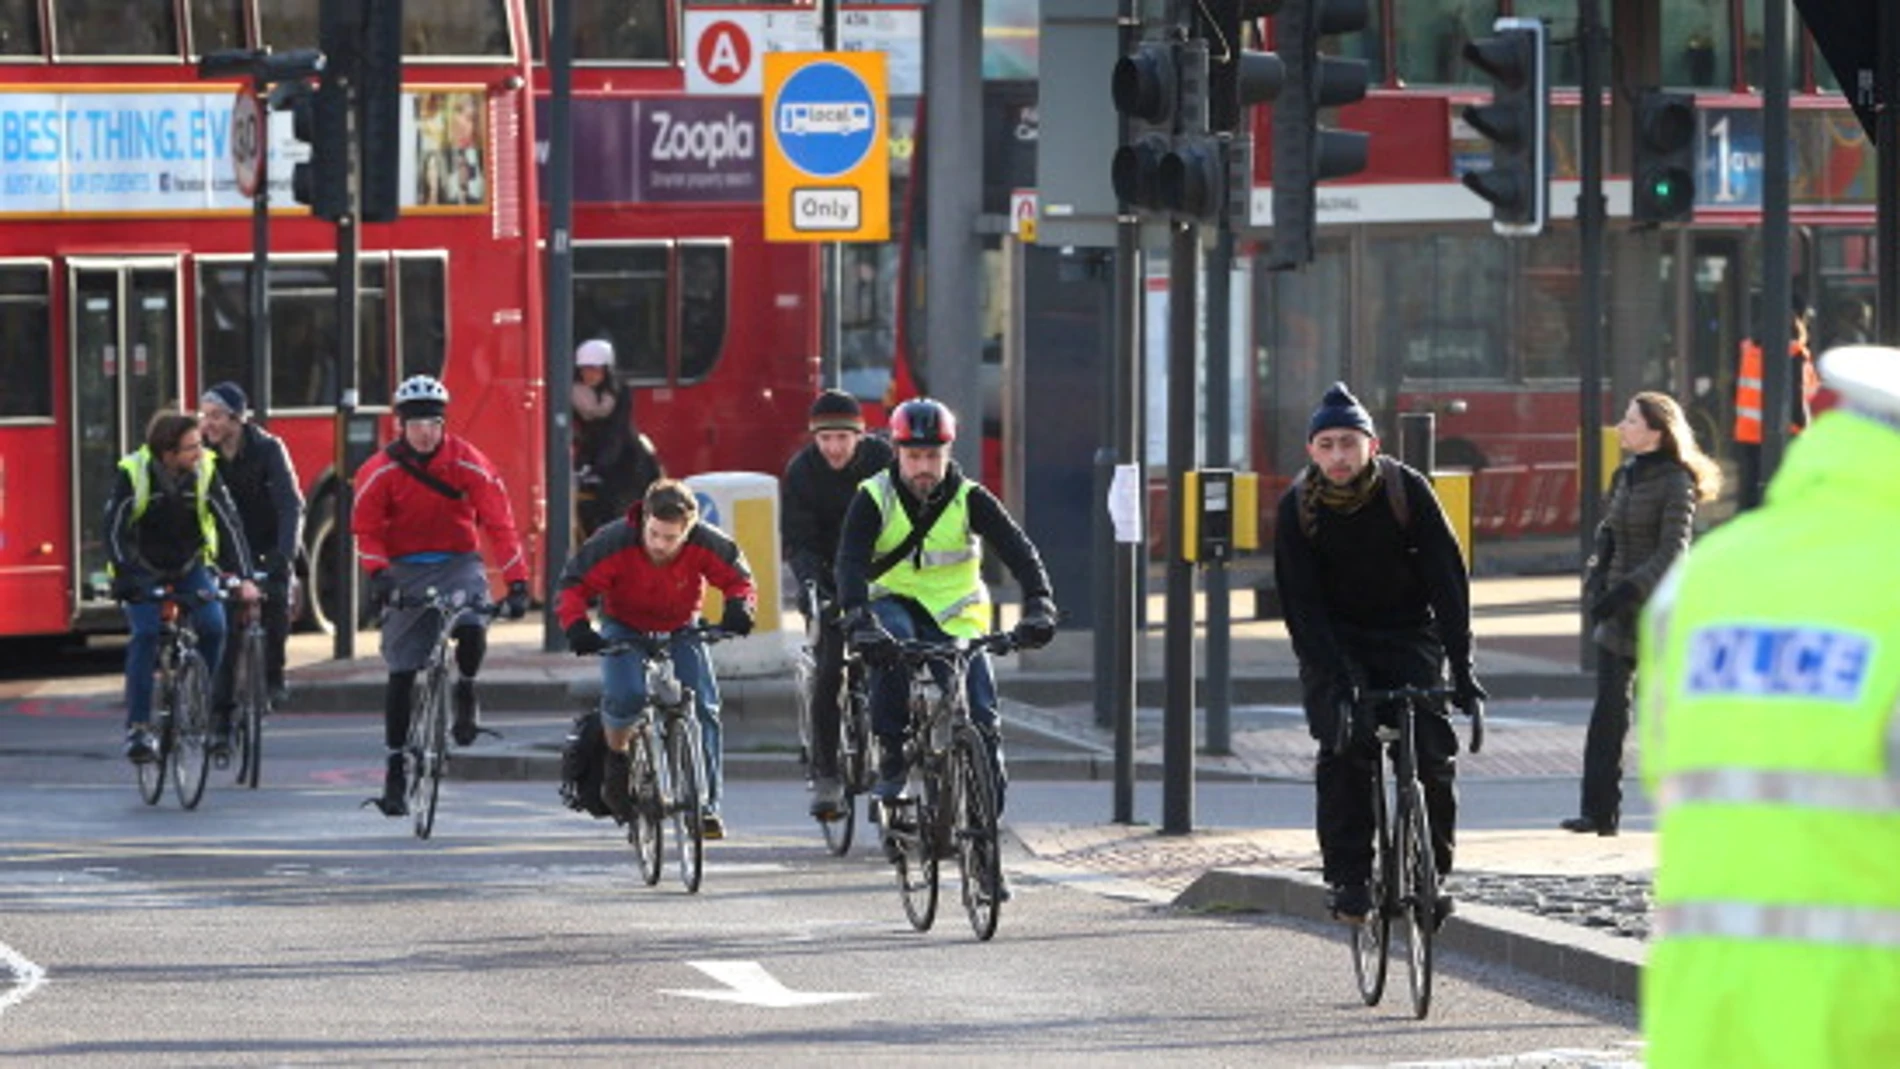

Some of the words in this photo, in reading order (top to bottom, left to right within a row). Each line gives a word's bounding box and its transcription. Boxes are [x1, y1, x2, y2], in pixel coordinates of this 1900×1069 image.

[708, 31, 741, 74] A
[809, 105, 850, 121] local
[651, 111, 754, 168] Zoopla
[801, 198, 851, 221] Only
